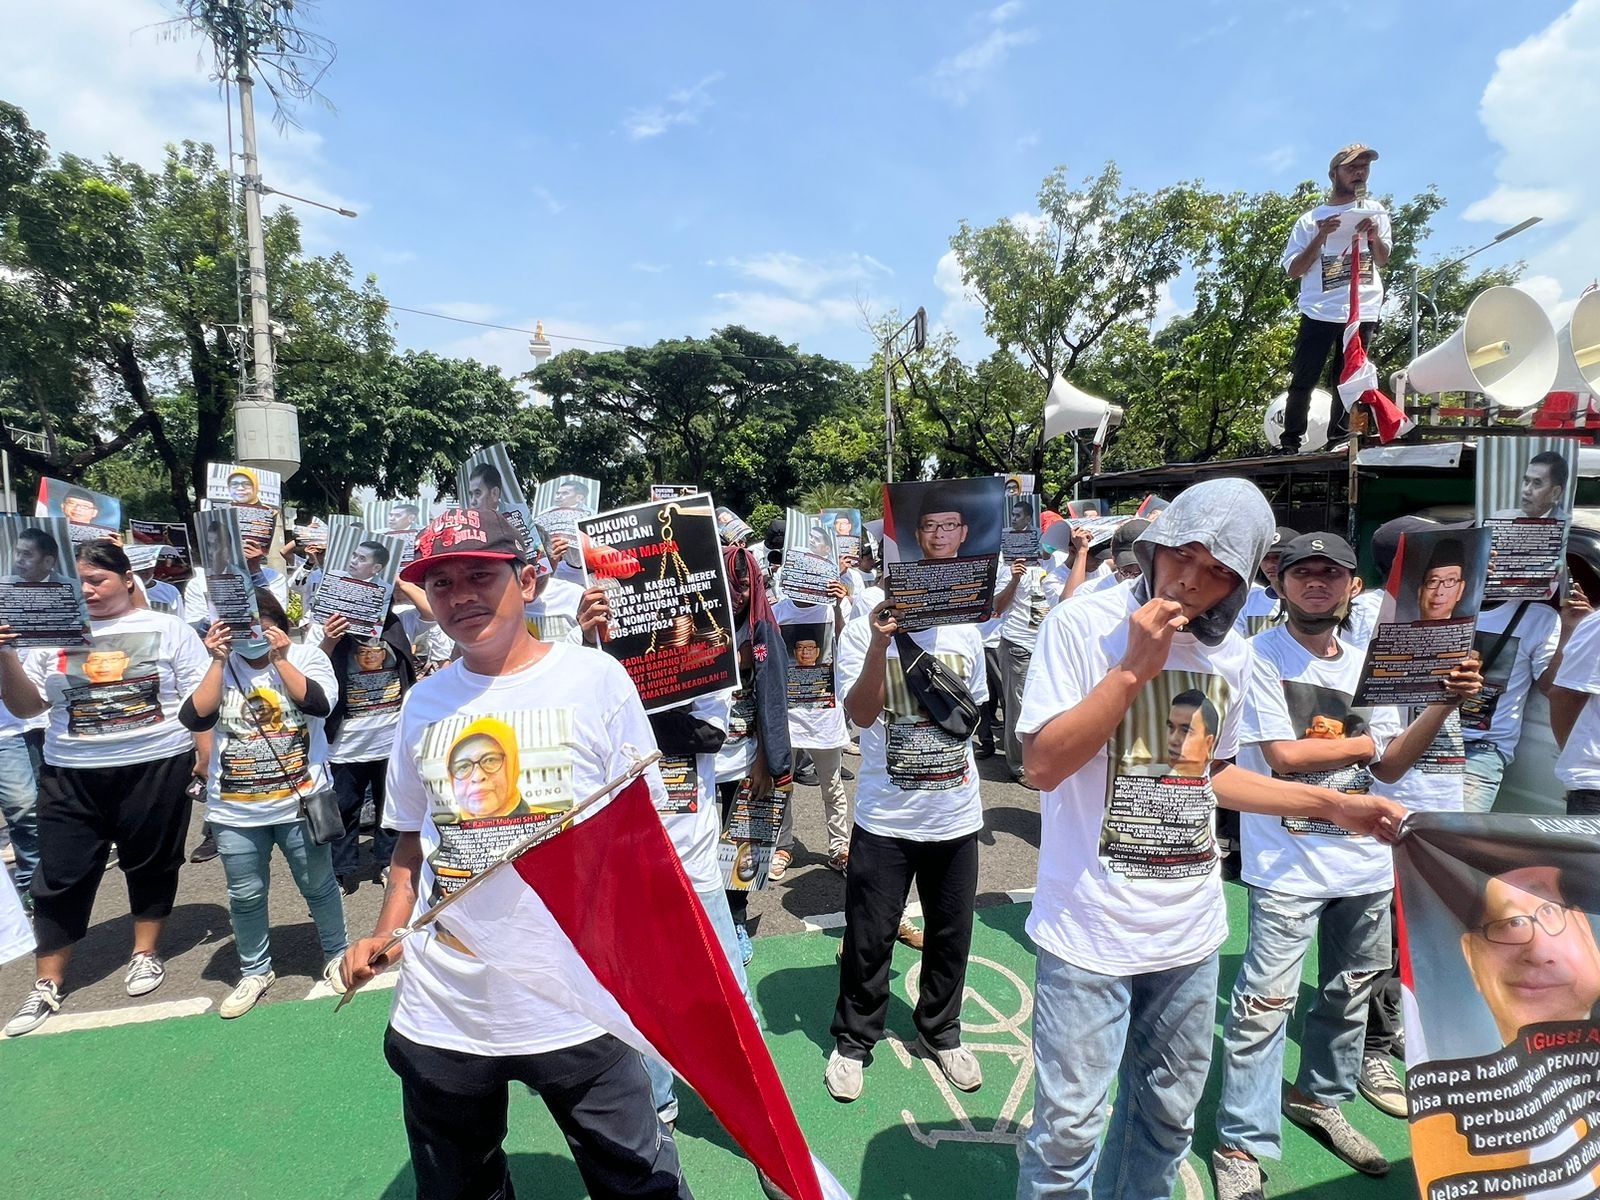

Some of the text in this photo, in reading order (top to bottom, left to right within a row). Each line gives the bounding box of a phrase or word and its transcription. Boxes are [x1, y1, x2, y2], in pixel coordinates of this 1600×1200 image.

[586, 515, 638, 536] DUKUNG
[590, 525, 654, 549] KEADILAN!
[1311, 540, 1324, 550] S
[593, 547, 638, 566] LAWAN
[645, 577, 676, 591] KASUS
[686, 570, 717, 583] MEREK
[609, 581, 711, 608] OLO BY RALPH LAUREN!
[612, 597, 680, 618] OLAK PUTUSAN
[624, 612, 657, 626] NOMOR
[670, 607, 677, 617] 9
[680, 604, 692, 615] PK
[702, 599, 722, 611] PDT.
[609, 619, 674, 640] SUS-HKI/2024
[620, 653, 656, 667] EADILAN
[627, 665, 645, 675] KAN
[647, 657, 680, 671] BARANG
[647, 666, 679, 680] TUNTAS
[647, 676, 677, 689] HUKUM
[641, 684, 680, 700] AMATKAN
[682, 673, 719, 689] KEADILAN
[473, 819, 495, 828] Rahmi
[496, 816, 521, 826] Mulyati
[523, 815, 533, 823] SH
[534, 813, 546, 821] MH
[1533, 1029, 1582, 1052] Gusti
[1409, 1055, 1518, 1091] Kenapa hakim
[1412, 1051, 1600, 1115] bisa memenangkan PENINJ
[1463, 1097, 1542, 1131] perbuatan
[1542, 1073, 1591, 1103] melawan
[1475, 1110, 1567, 1149] bertentangan
[1484, 1167, 1563, 1193] Mohindar
[1565, 1154, 1582, 1177] HB
[1581, 1140, 1600, 1166] didu
